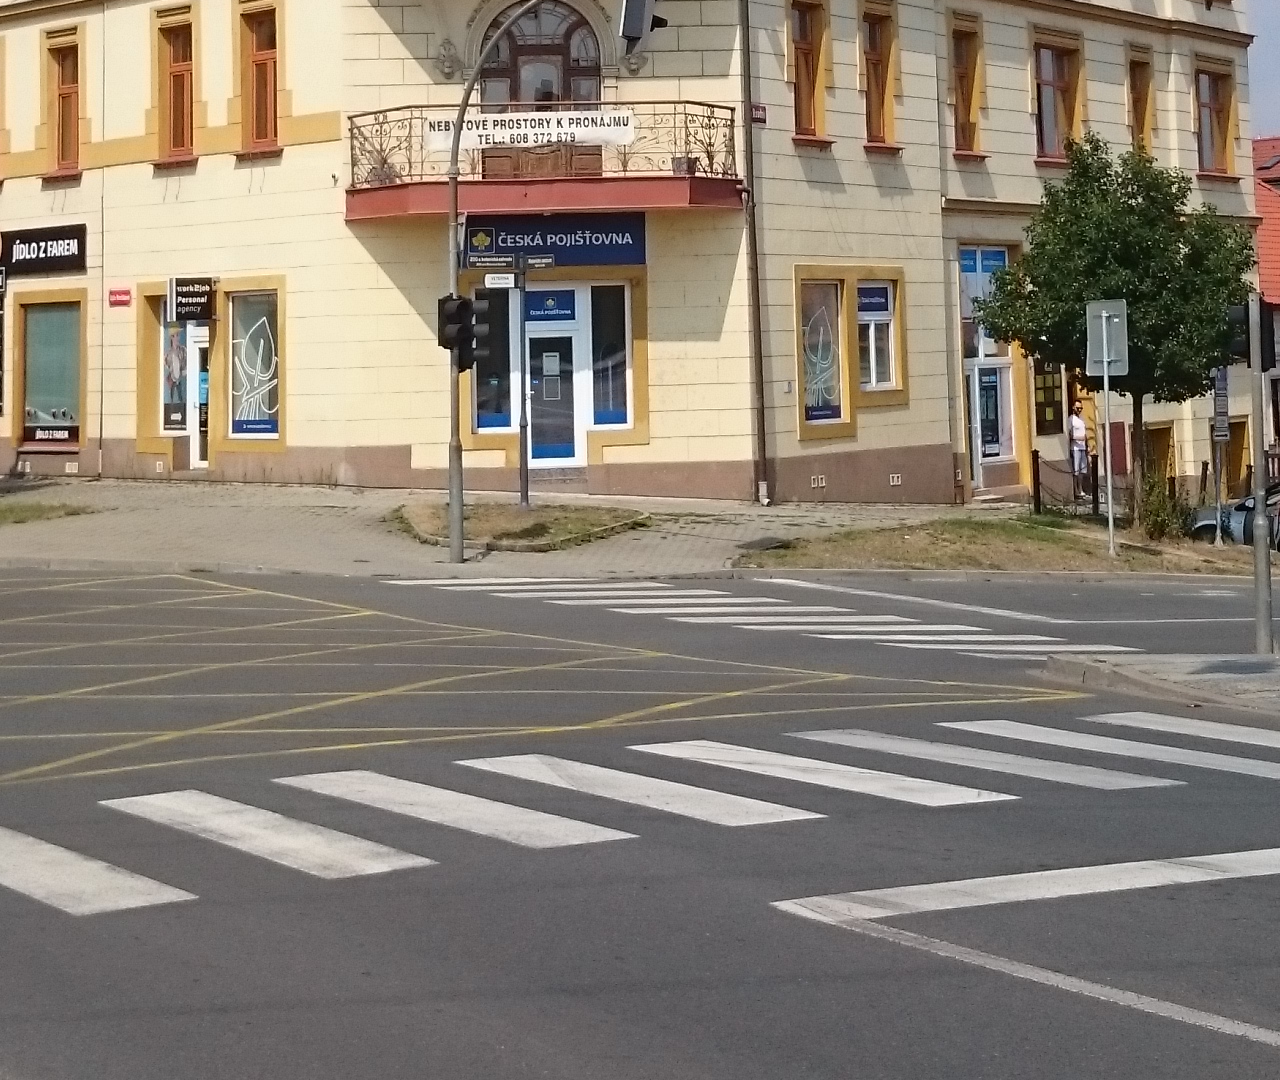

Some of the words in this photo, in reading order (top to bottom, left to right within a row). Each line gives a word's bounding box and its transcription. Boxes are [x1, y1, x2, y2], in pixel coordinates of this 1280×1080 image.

[492, 117, 551, 130] PROSTORY
[556, 117, 564, 129] K
[568, 115, 630, 128] PRONÁJMU
[477, 133, 505, 146] TEL.:
[509, 133, 529, 144] 608
[532, 133, 553, 143] 372
[556, 132, 576, 143] 679
[497, 231, 543, 247] ČESKÁ
[546, 230, 633, 248] POJIŠŤOVNA
[12, 239, 38, 263] JÍDLO
[39, 241, 46, 257] Z
[47, 238, 78, 257] FAREM
[177, 295, 207, 304] Personal
[177, 305, 201, 314] agency
